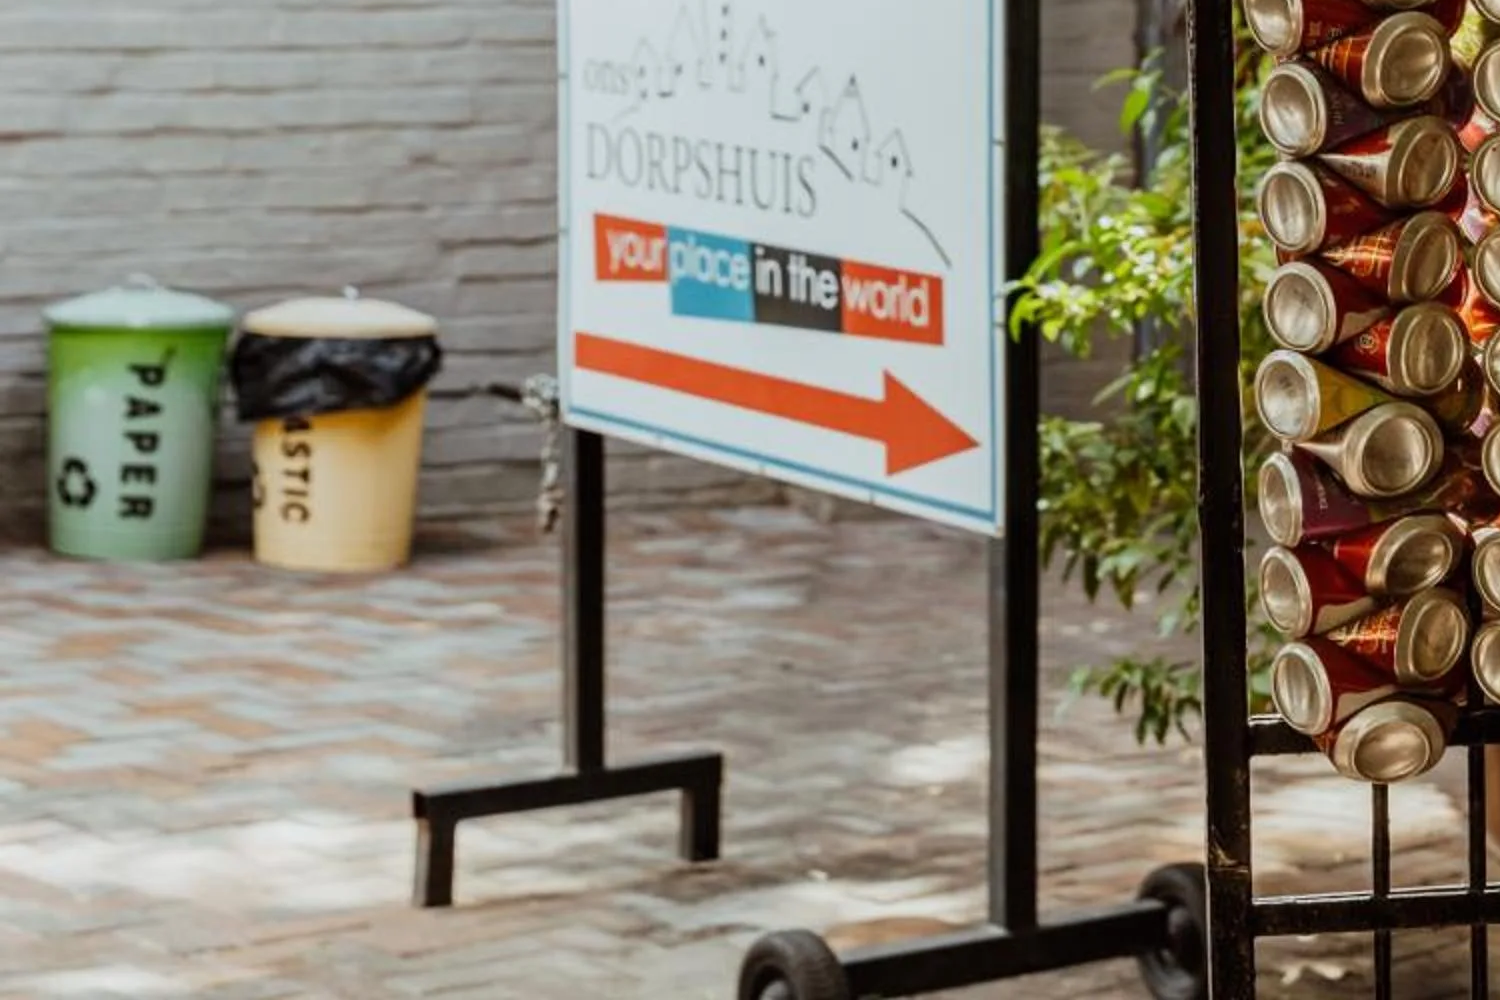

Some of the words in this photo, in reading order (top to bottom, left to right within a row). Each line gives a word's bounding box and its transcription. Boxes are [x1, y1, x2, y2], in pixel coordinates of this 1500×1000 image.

[586, 121, 817, 219] DORPSHUIS
[606, 228, 666, 275] your
[669, 233, 751, 291] place
[755, 245, 782, 297] in
[787, 253, 839, 310] the
[841, 272, 929, 328] world
[119, 363, 167, 519] PAPER
